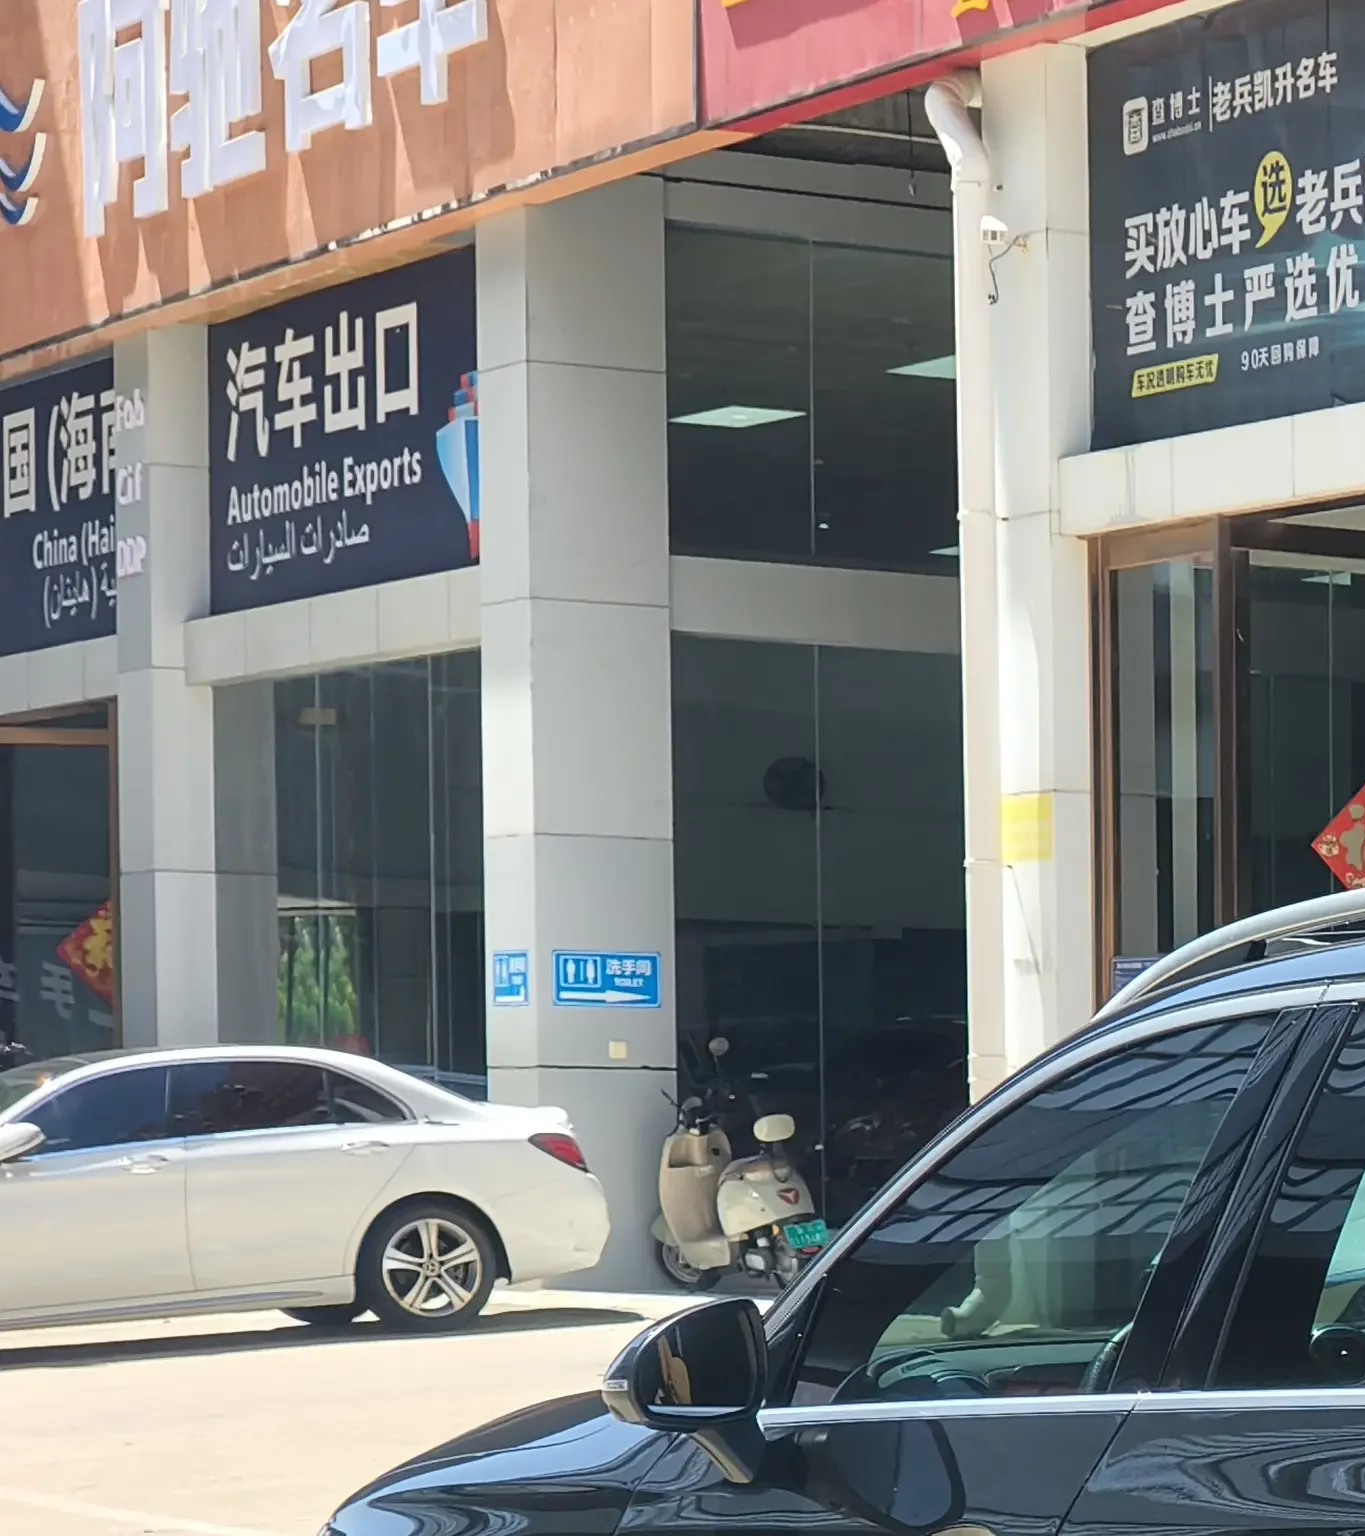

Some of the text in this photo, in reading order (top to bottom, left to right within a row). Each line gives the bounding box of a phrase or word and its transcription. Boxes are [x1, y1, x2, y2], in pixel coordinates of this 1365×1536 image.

[1212, 51, 1339, 122] 老兵凯升名车
[226, 301, 419, 463] 汽车出口
[227, 447, 422, 526] Automobile Exports
[33, 527, 78, 569] China
